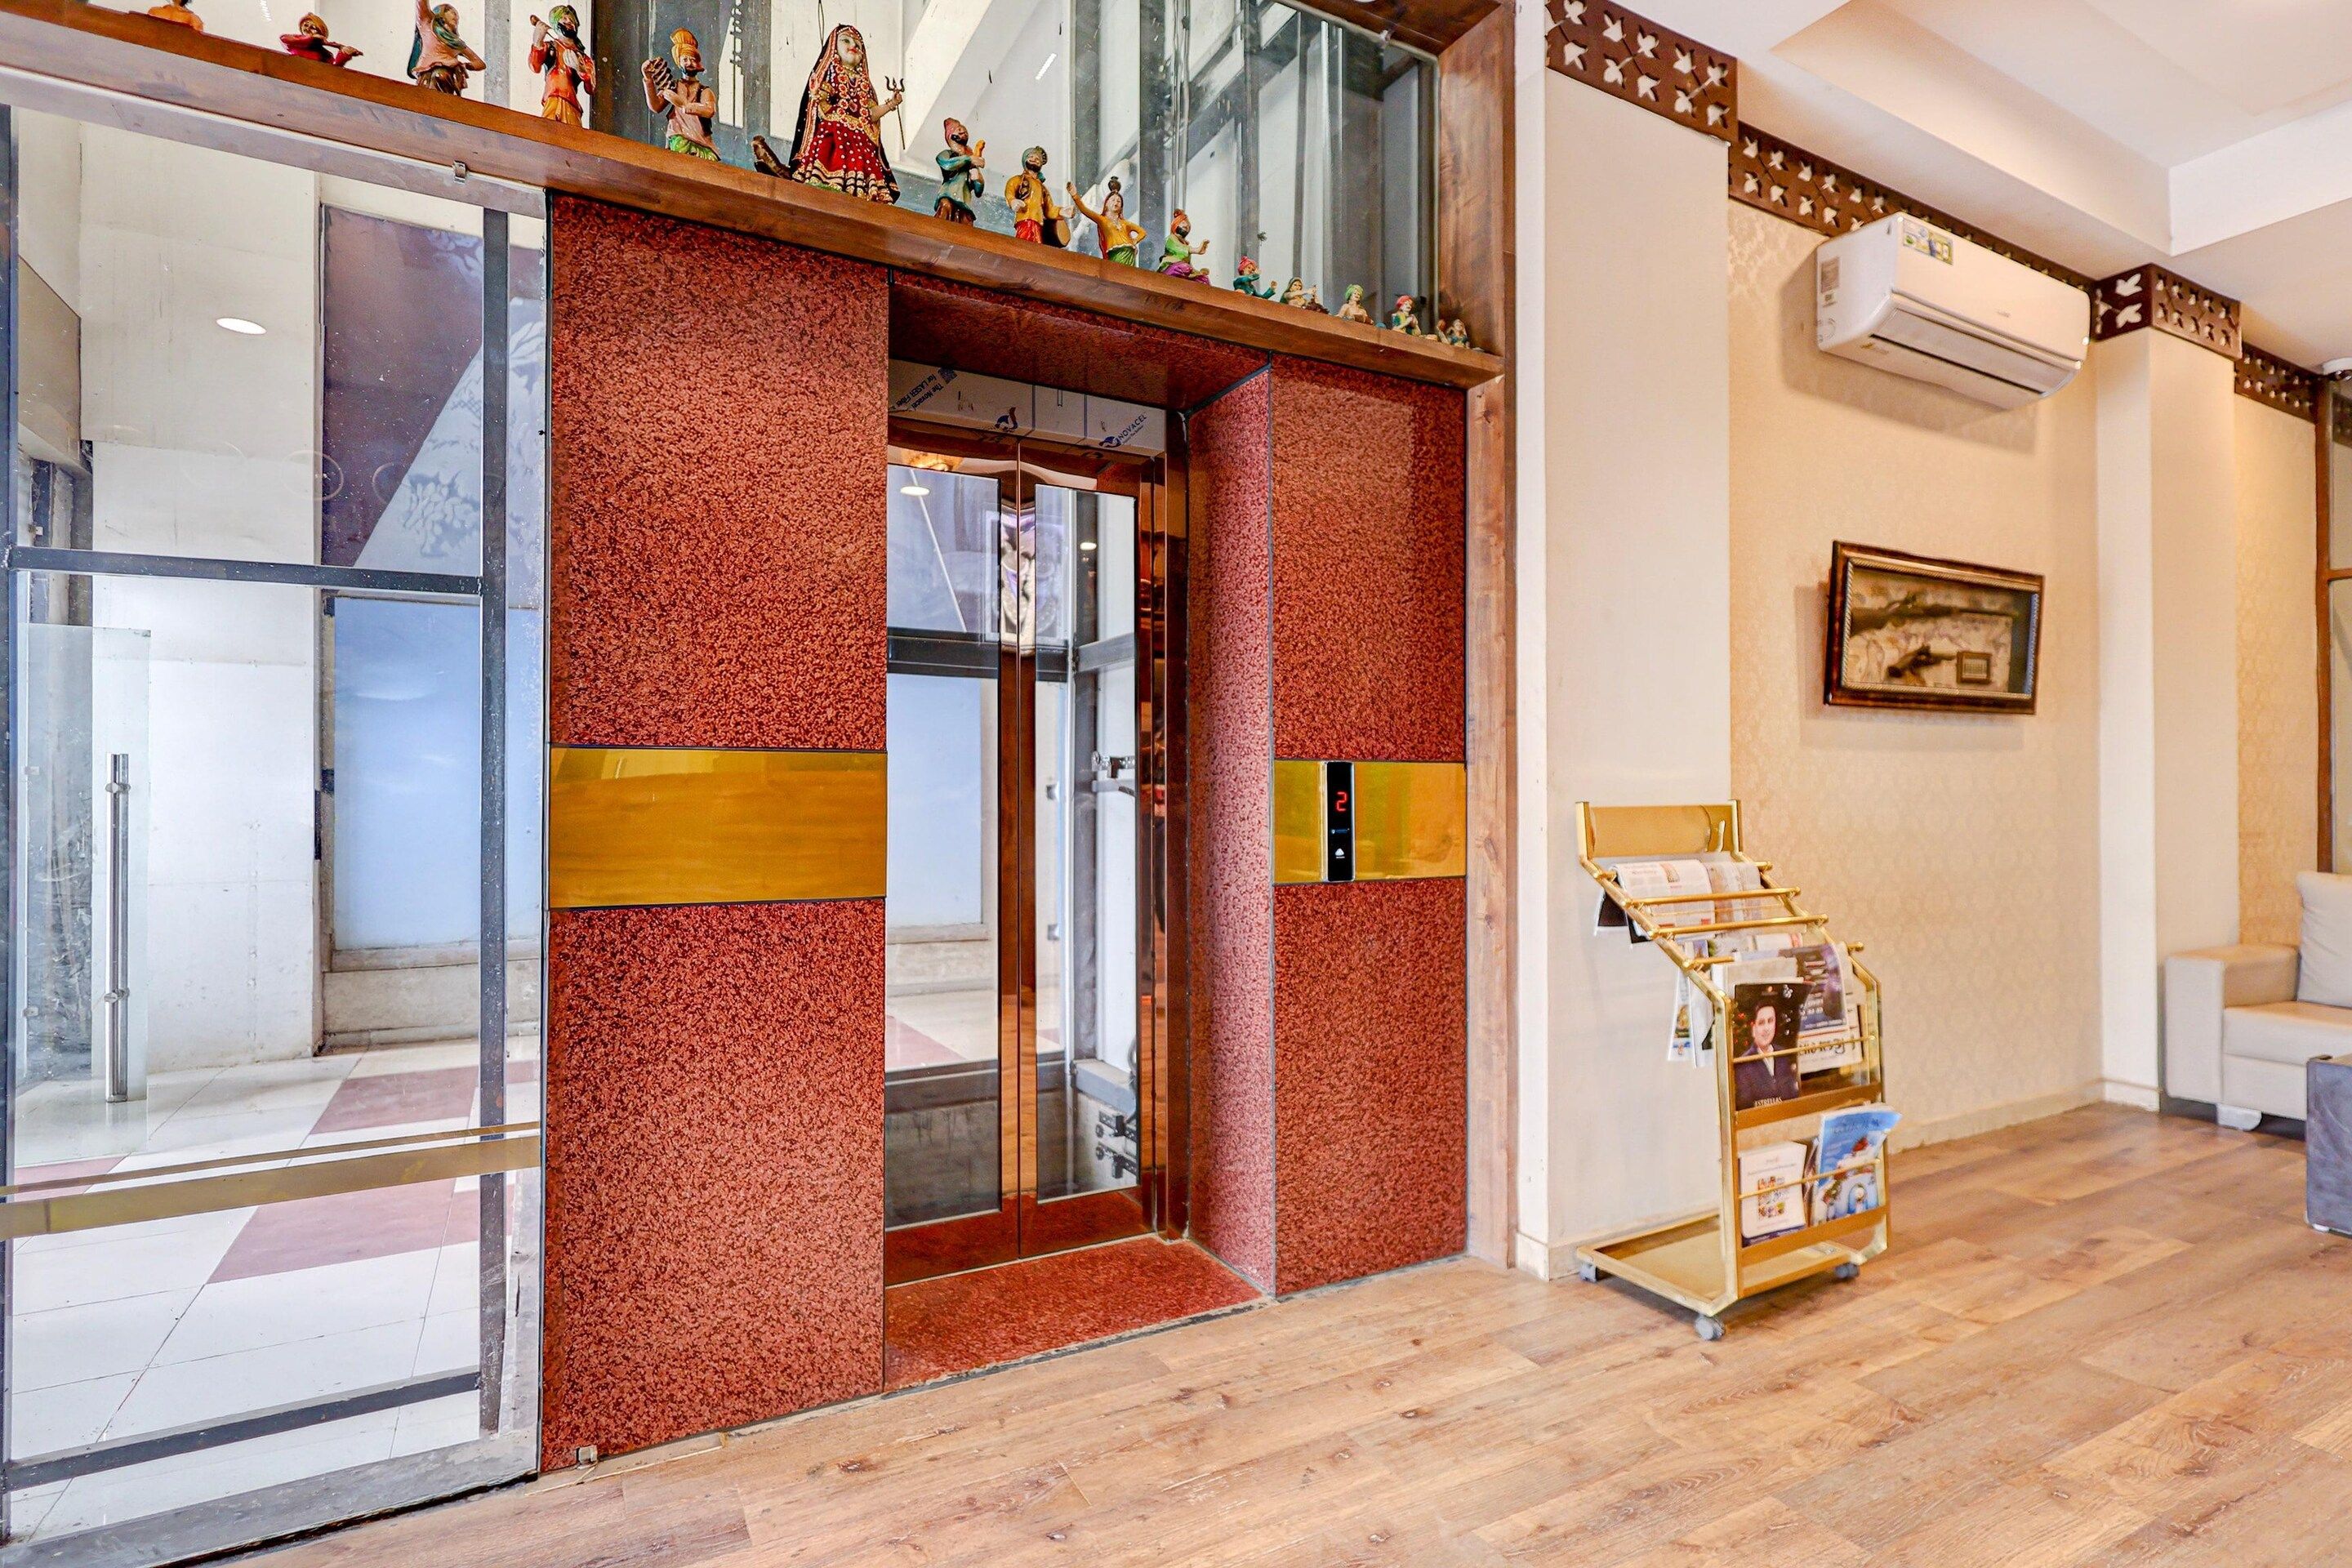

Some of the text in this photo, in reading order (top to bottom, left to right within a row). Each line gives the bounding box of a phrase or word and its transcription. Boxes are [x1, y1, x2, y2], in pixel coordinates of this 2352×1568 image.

[927, 374, 937, 383] for
[909, 381, 929, 398] LASER
[932, 382, 944, 393] The
[1118, 414, 1147, 440] NOVACEL
[1336, 791, 1348, 812] 2
